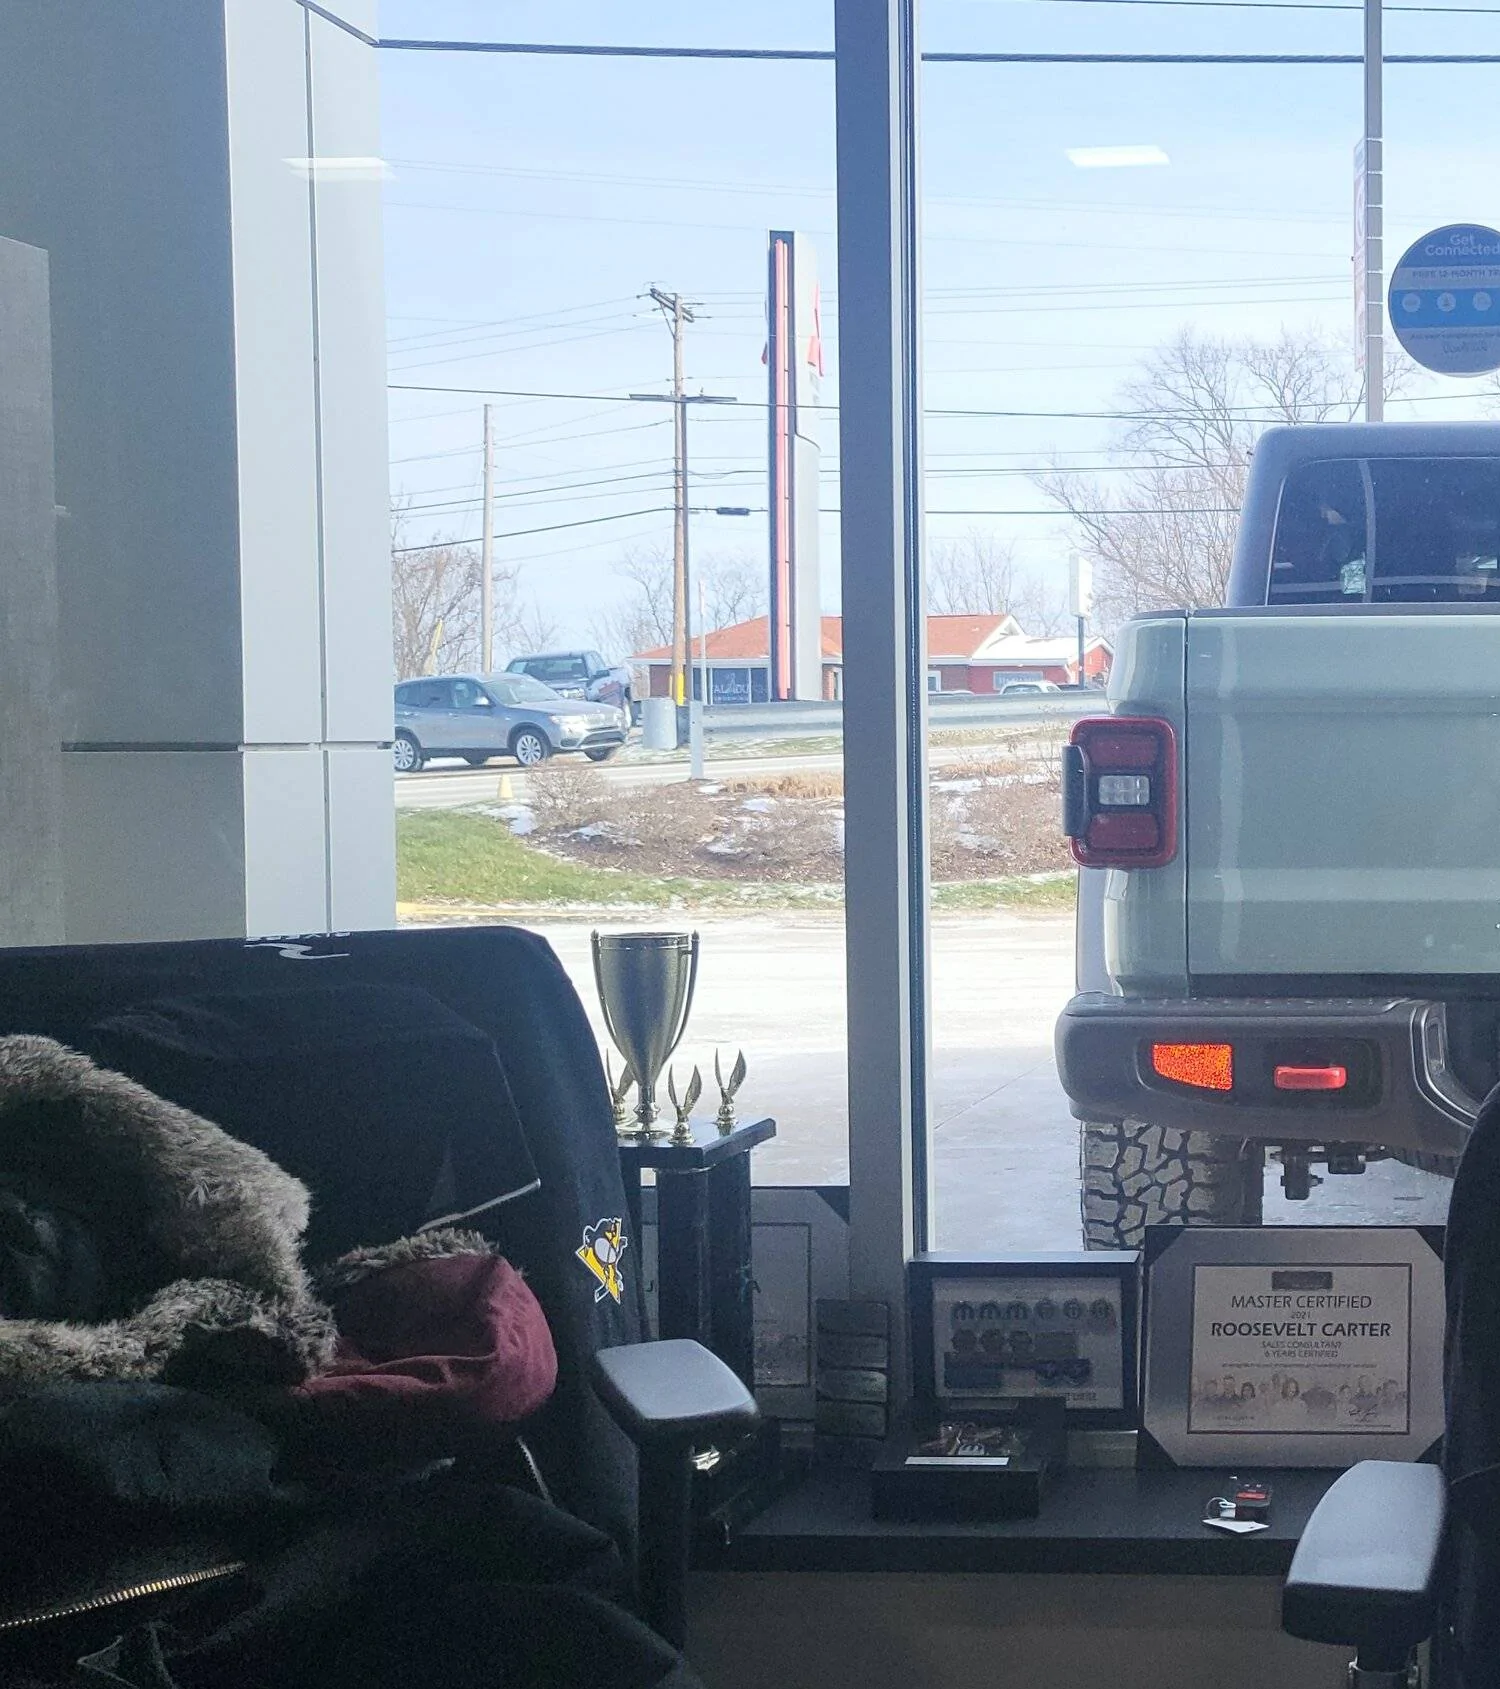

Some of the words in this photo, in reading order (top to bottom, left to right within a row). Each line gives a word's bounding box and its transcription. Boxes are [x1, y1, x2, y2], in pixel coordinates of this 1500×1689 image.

[1449, 234, 1475, 246] Get
[1425, 243, 1500, 256] Connected
[1231, 1295, 1291, 1309] MASTER
[1296, 1295, 1372, 1309] CERTIFIED
[1290, 1311, 1312, 1320] 2021
[1211, 1322, 1315, 1337] ROOSEVELT
[1321, 1322, 1392, 1337] CARTER
[1261, 1340, 1285, 1349] SALES
[1286, 1340, 1342, 1349] CONSULTANT
[1271, 1350, 1297, 1359] YEARS
[1299, 1350, 1339, 1358] CERTIFIED
